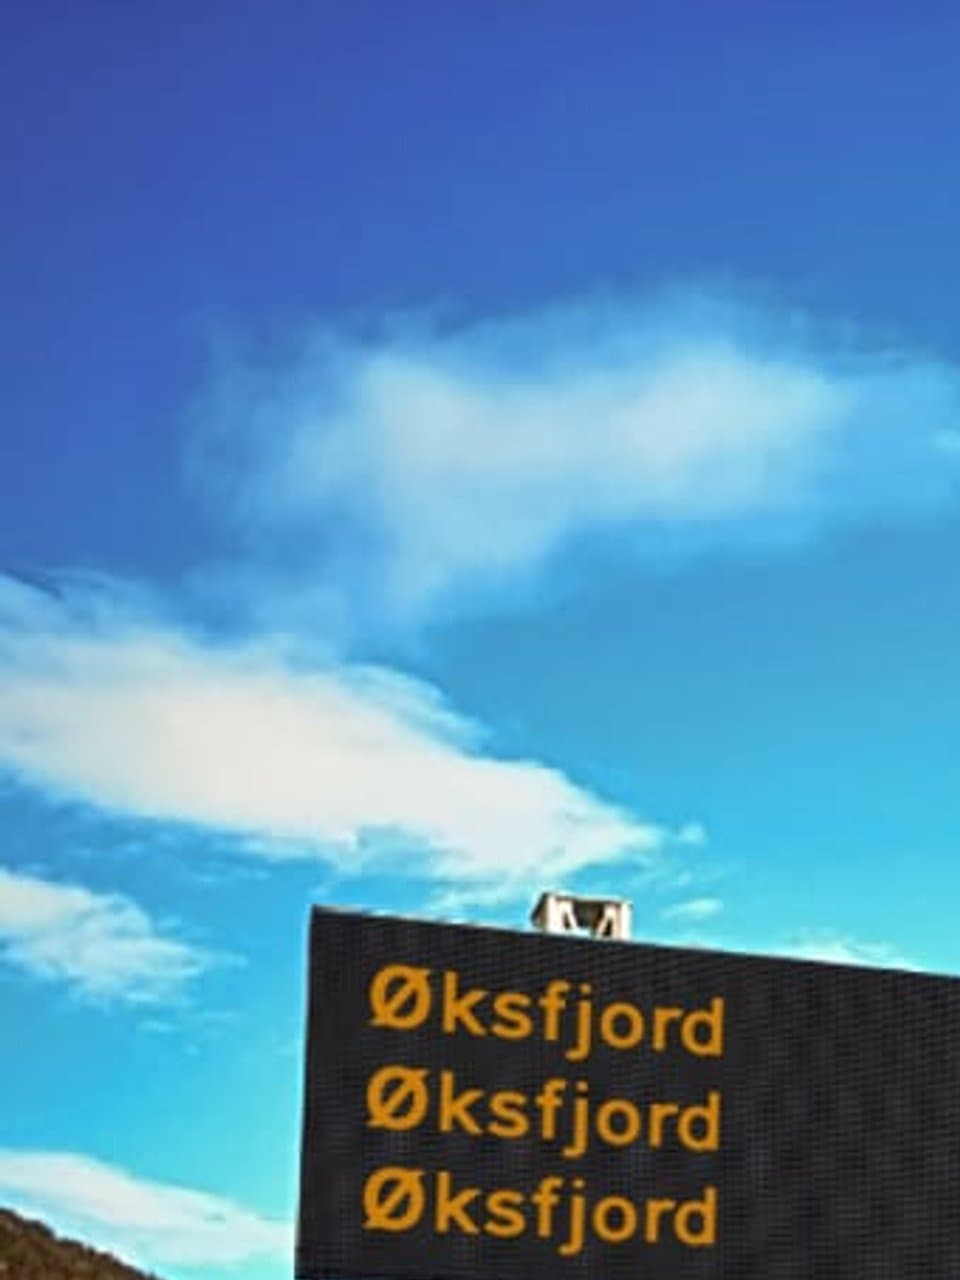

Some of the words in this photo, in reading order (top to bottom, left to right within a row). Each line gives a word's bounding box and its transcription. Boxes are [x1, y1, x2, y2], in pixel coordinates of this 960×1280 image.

[369, 964, 724, 1060] Øksfjord
[366, 1065, 720, 1158] Øksfjord
[362, 1166, 716, 1255] Øksfjord
